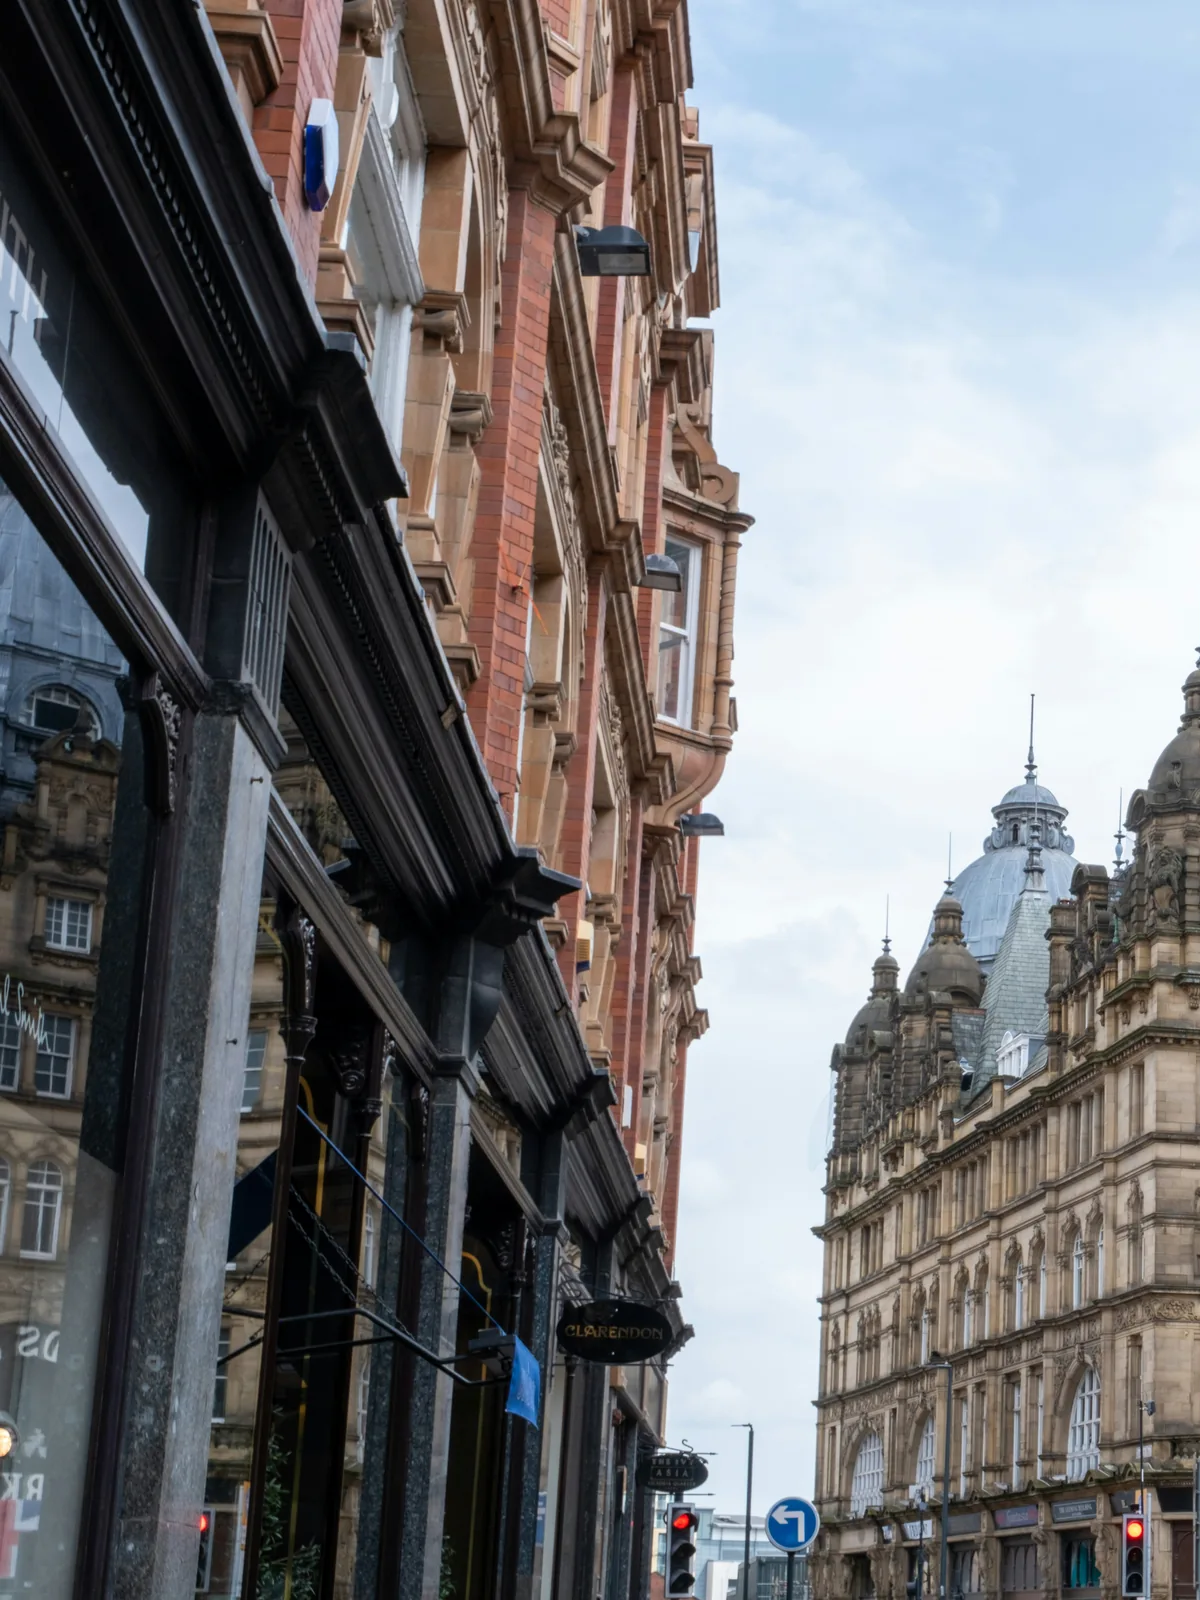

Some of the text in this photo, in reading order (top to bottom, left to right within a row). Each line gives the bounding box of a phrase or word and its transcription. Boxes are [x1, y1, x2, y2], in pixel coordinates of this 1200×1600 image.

[0, 189, 48, 346] ITH
[564, 1324, 664, 1340] CLARENDON
[656, 1468, 689, 1477] ASIA
